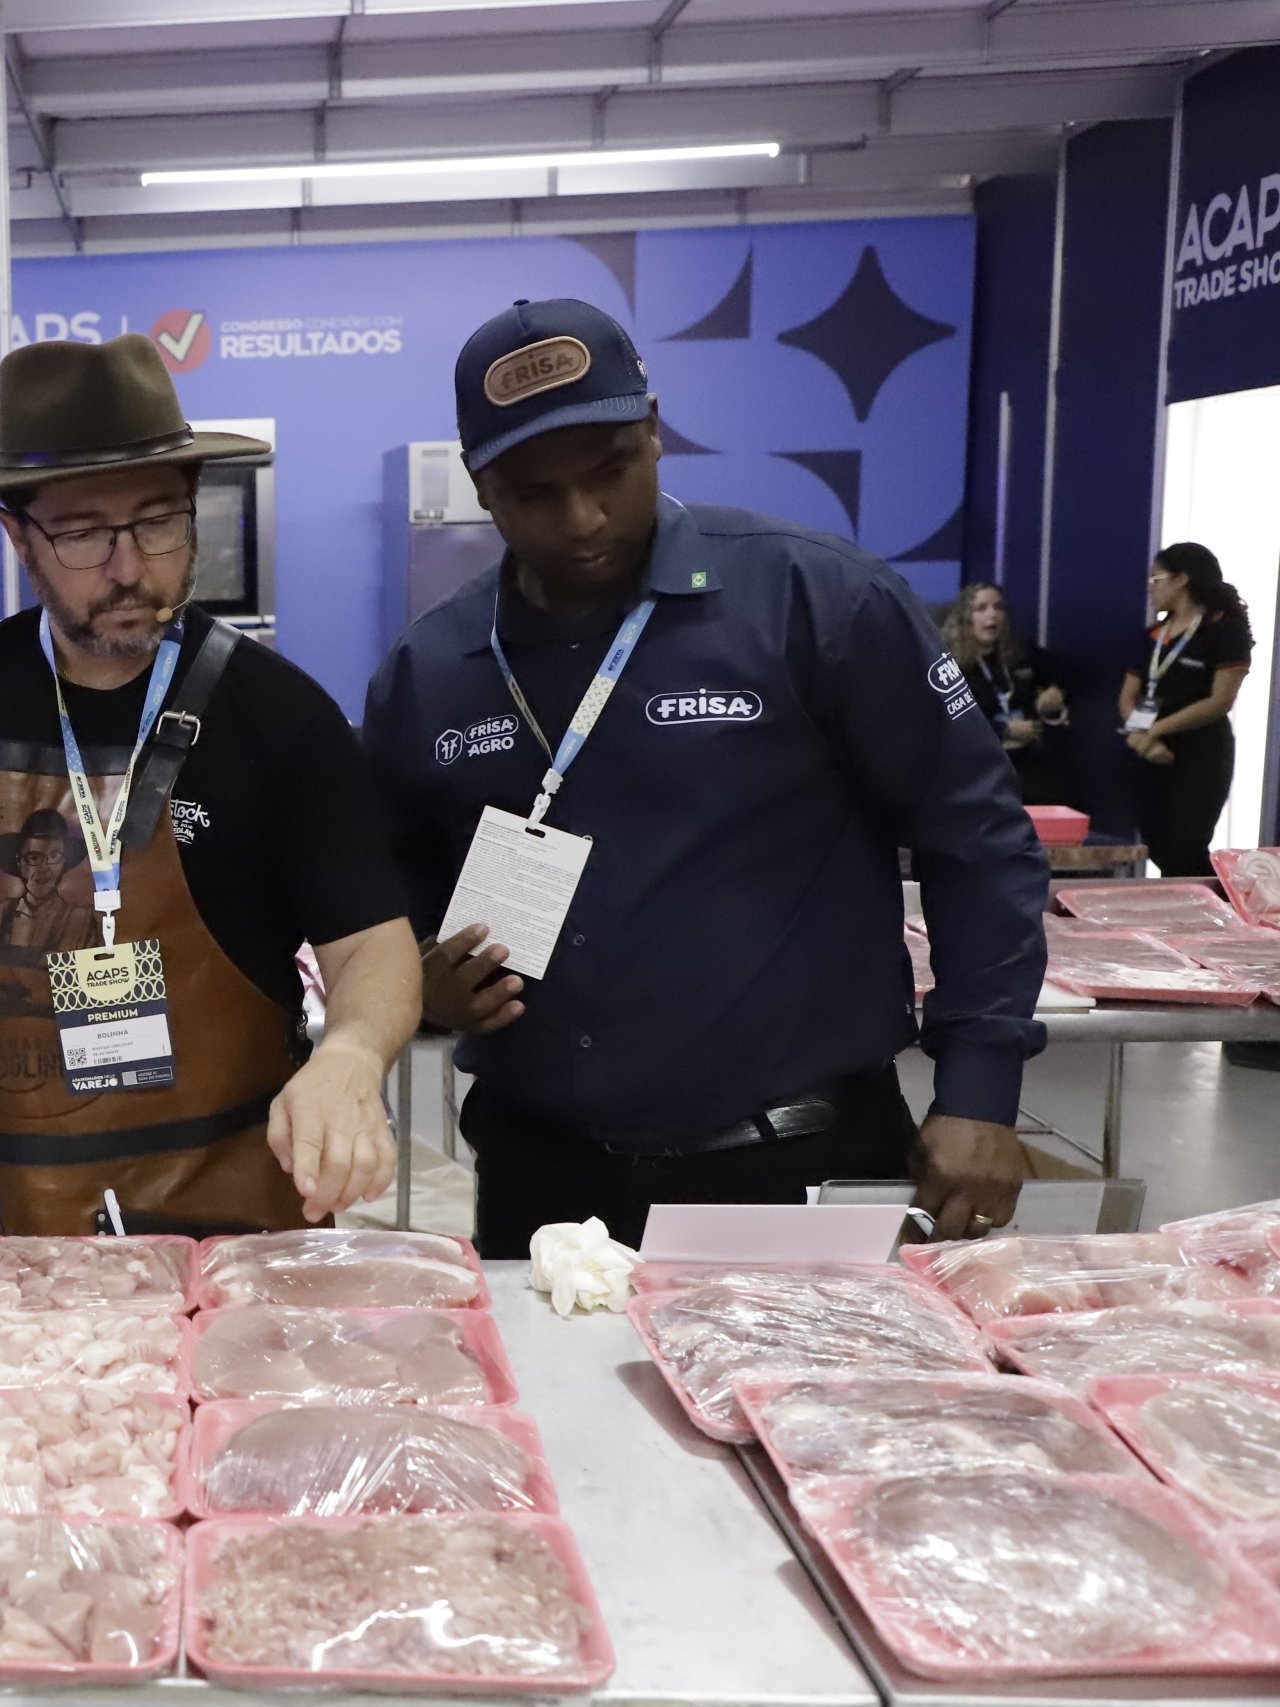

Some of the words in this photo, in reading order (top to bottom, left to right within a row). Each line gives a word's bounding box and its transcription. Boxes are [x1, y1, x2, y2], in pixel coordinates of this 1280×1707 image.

[1174, 265, 1238, 309] TRADE
[221, 318, 303, 333] CONGRESSO
[221, 329, 402, 359] RESULTADOS
[500, 353, 574, 389] FRISA
[656, 688, 753, 718] FRISA
[947, 696, 967, 715] CASA
[469, 718, 514, 739] FRISA
[467, 736, 514, 757] AGRO
[86, 966, 129, 982] ACAPS
[109, 977, 130, 986] SHOW
[87, 1008, 139, 1023] PREMIUM
[97, 1029, 129, 1039] BOLINHA
[72, 1078, 119, 1091] VAREJO
